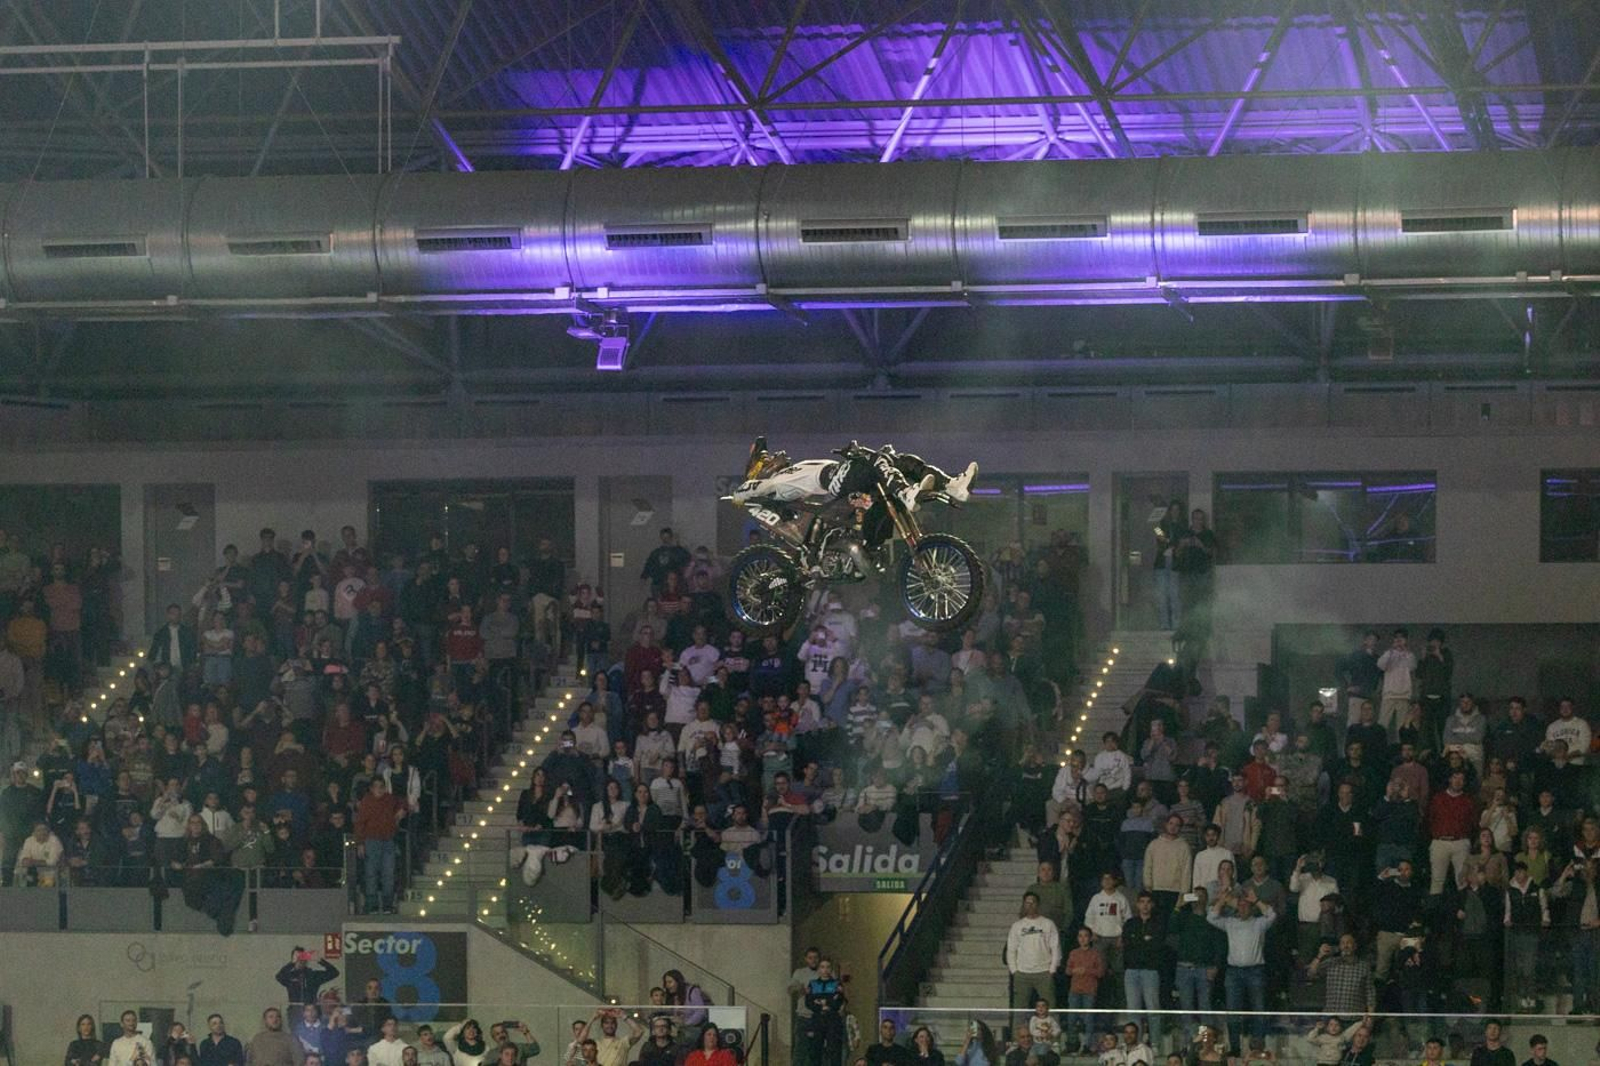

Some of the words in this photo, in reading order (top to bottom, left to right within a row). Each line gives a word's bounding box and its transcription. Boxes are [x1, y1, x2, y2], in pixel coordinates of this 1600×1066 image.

[811, 844, 920, 874] Salida
[344, 932, 423, 955] Sector
[377, 931, 441, 1023] 8
